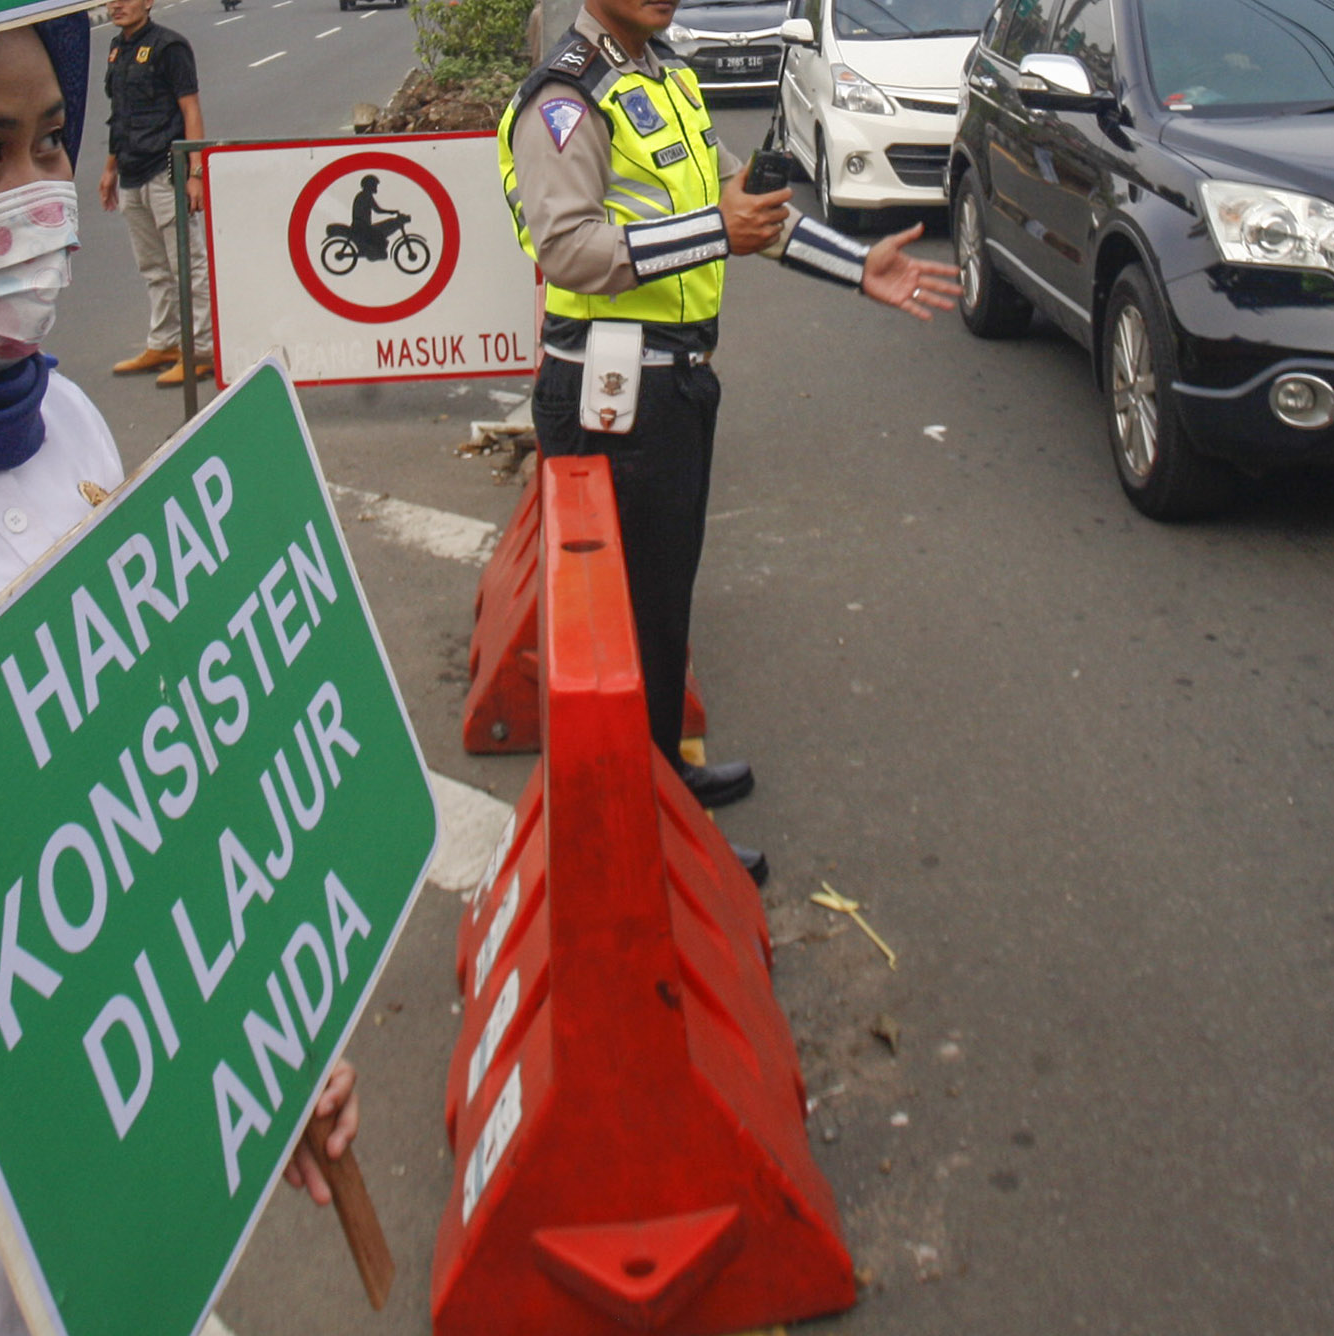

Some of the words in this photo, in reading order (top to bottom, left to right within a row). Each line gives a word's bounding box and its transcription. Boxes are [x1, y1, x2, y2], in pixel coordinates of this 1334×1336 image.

[376, 335, 466, 369] MASUK
[478, 332, 527, 363] TOL
[0, 456, 233, 769] HARAP
[83, 951, 180, 1139] DI
[172, 682, 360, 1002] LAJUR
[213, 872, 371, 1196] ANDA
